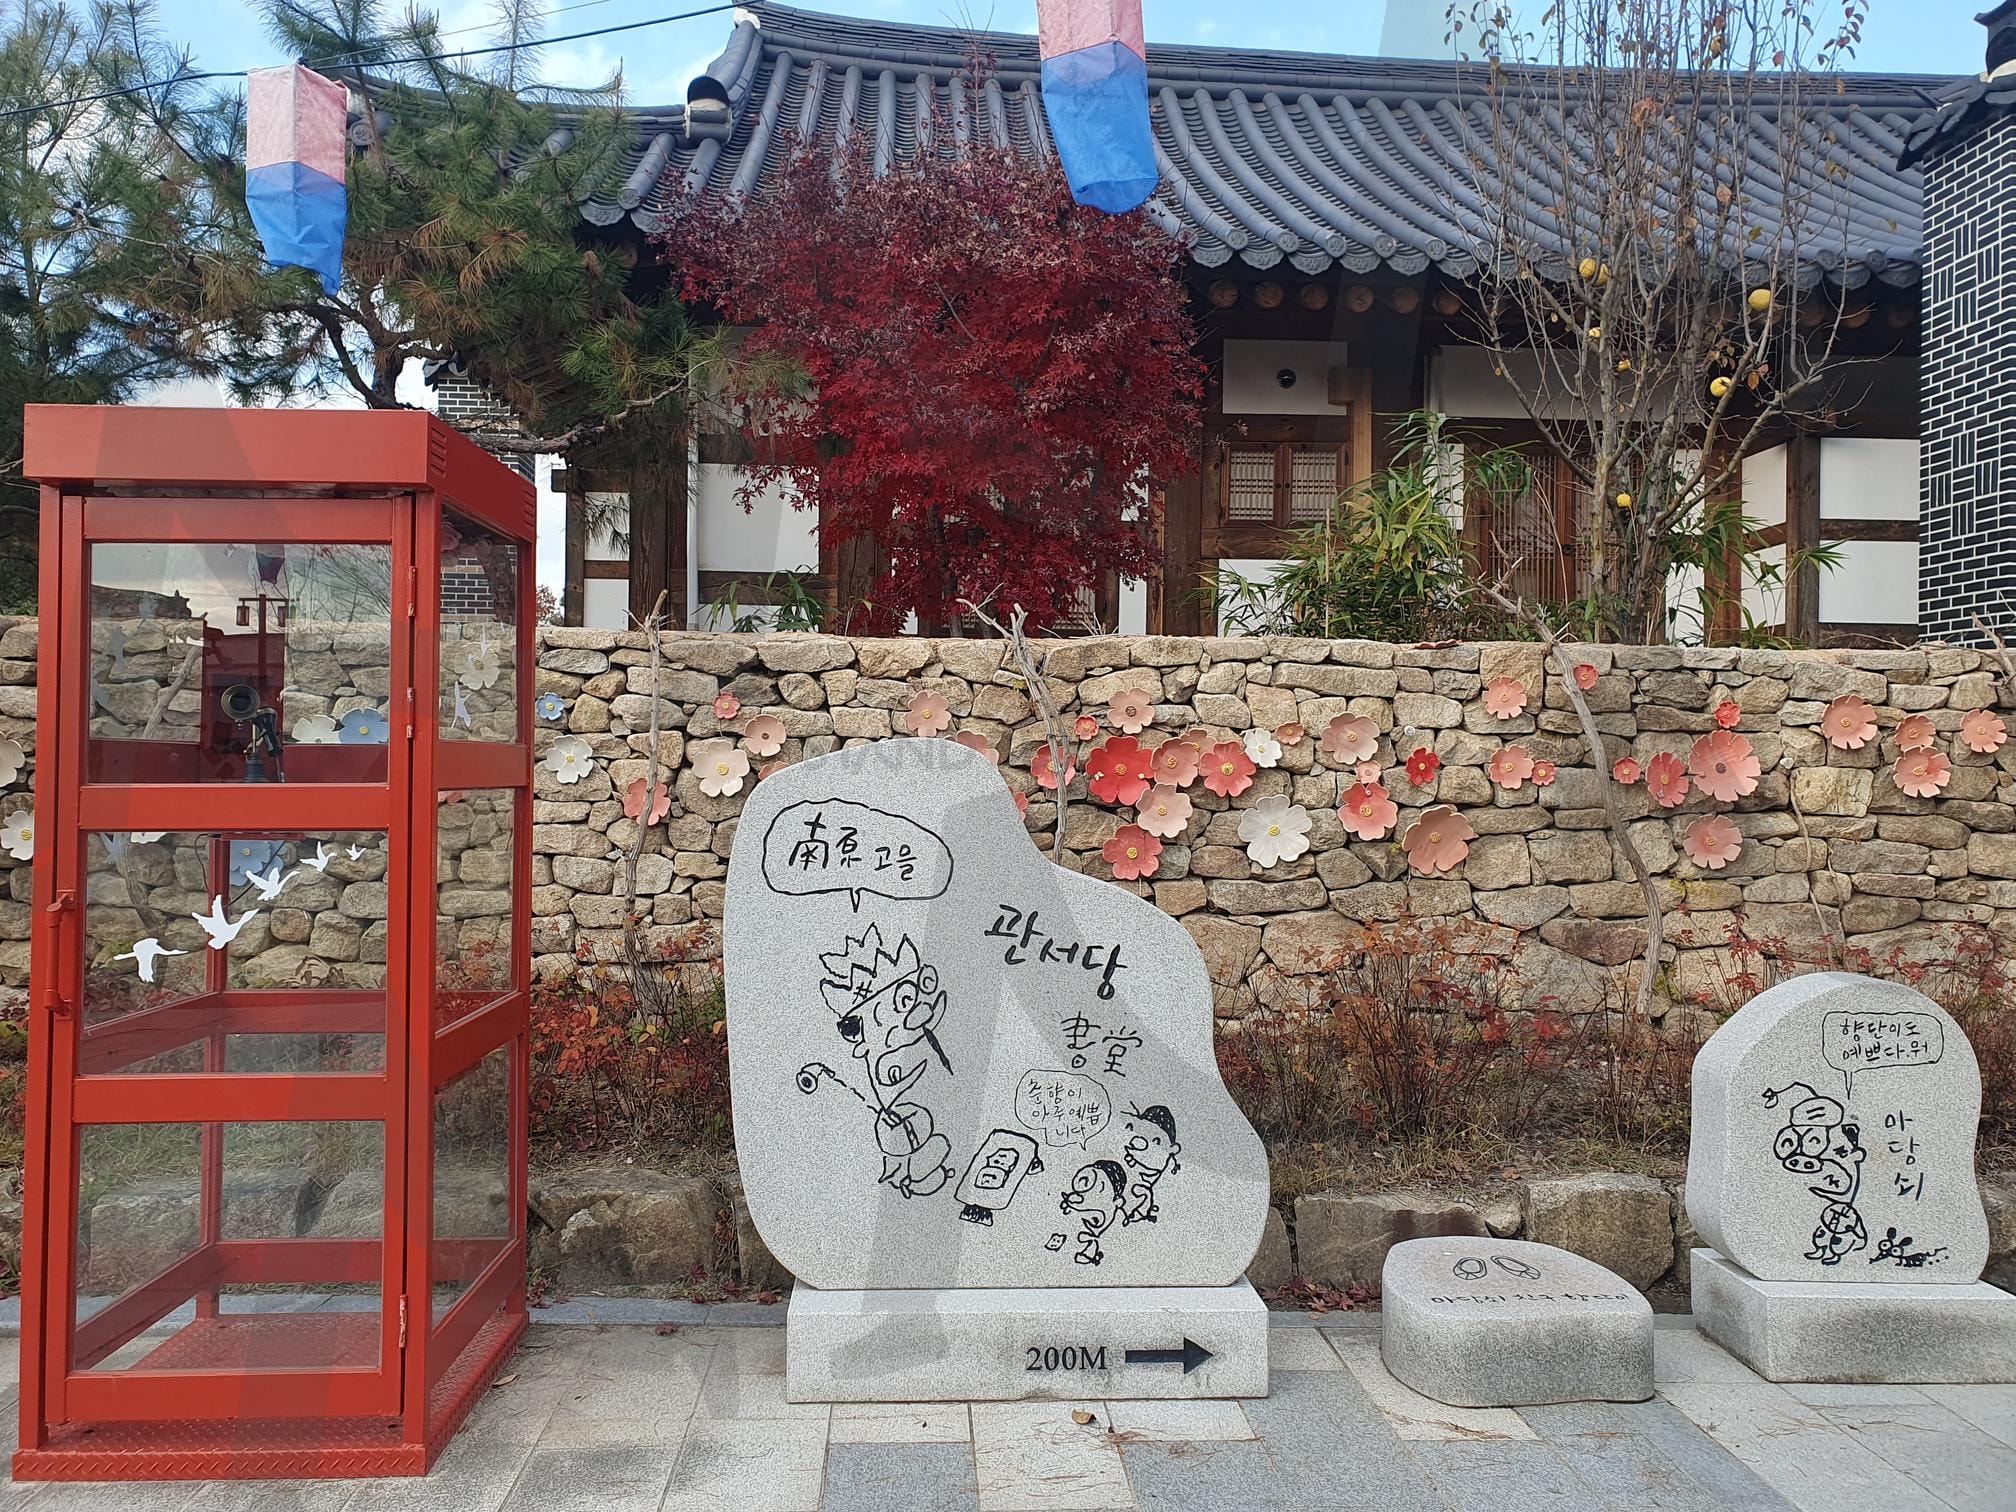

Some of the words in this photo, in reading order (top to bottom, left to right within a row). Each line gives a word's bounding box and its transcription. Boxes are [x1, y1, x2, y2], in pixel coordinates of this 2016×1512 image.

[873, 843, 918, 882] 고을
[1839, 1018, 1921, 1042] 향단이도
[1027, 1078, 1082, 1105] 춘향이
[1031, 1104, 1065, 1123] 아주
[1884, 1109, 1925, 1202] 마당쇠
[1025, 1346, 1108, 1371] 200M
